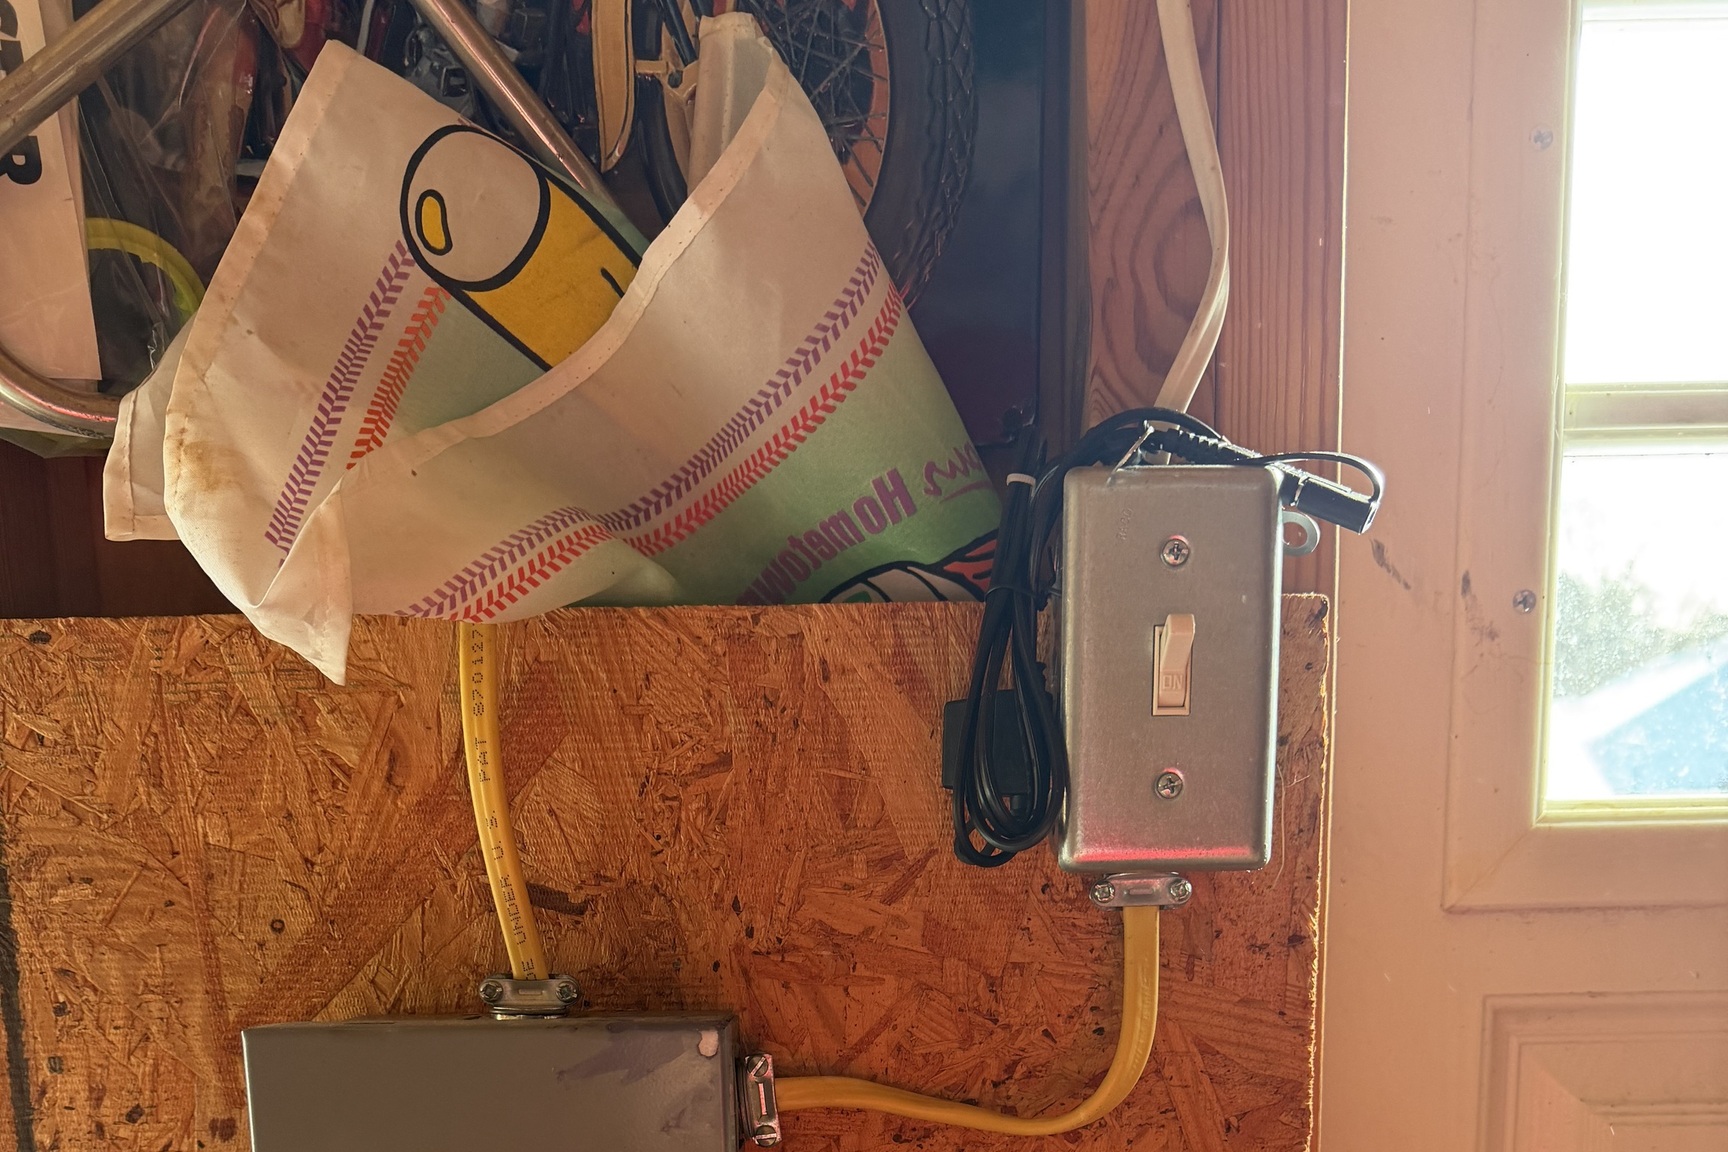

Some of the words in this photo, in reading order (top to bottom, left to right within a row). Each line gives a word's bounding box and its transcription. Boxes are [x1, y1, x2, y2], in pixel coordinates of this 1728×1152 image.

[1162, 674, 1184, 691] ON
[474, 736, 490, 784] PAT
[498, 874, 527, 947] UNDER
